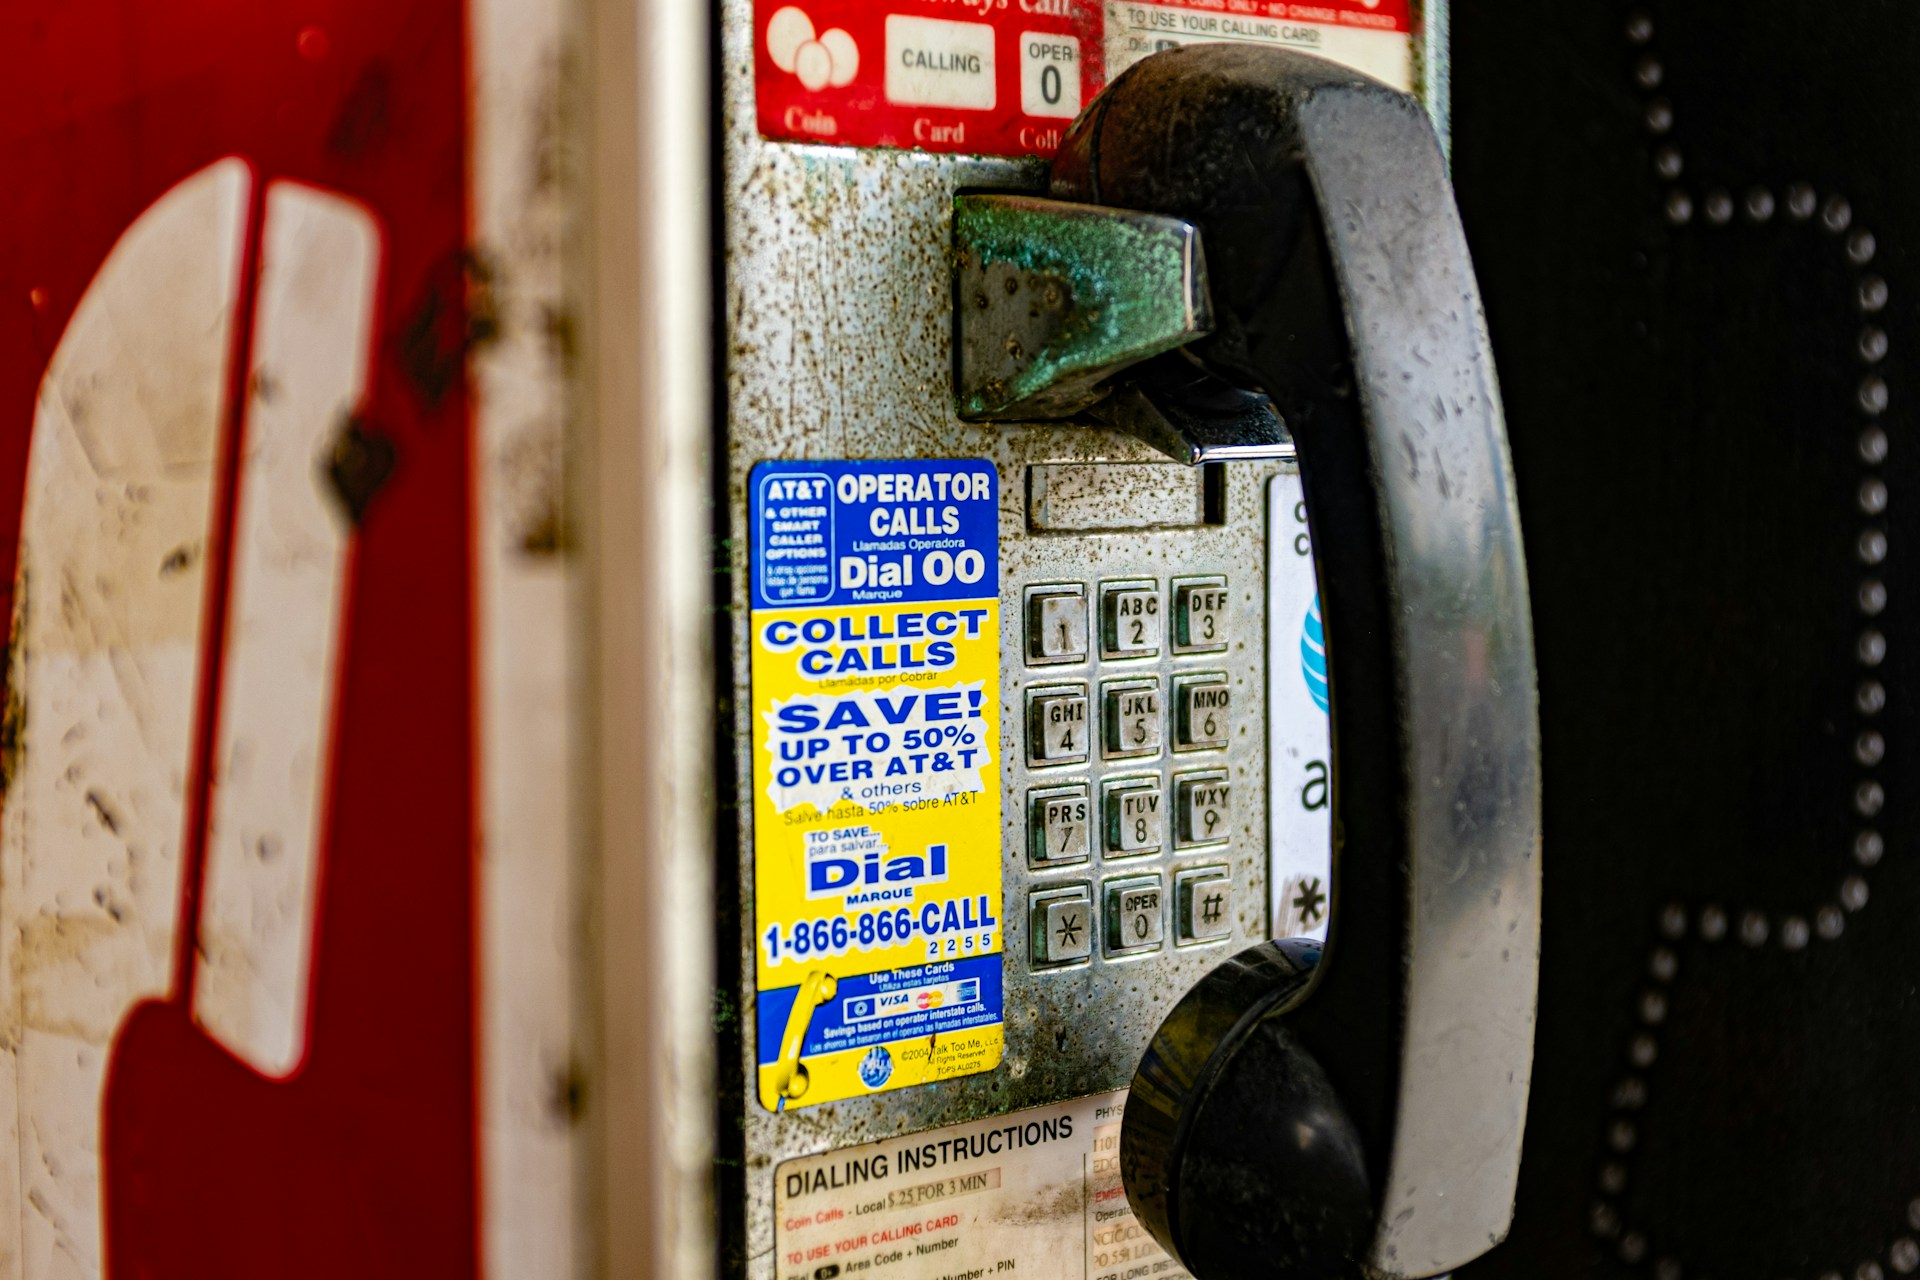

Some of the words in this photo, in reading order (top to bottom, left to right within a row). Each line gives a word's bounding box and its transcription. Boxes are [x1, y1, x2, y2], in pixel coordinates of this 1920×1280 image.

[1128, 8, 1146, 24] TO
[1151, 11, 1177, 27] USE
[1181, 15, 1217, 31] YOUR
[1222, 20, 1278, 38] CALLING
[902, 49, 981, 75] CALLING
[1029, 42, 1074, 62] OPER
[1041, 65, 1062, 105] 0
[784, 106, 838, 136] Coin
[913, 117, 965, 144] Card
[1020, 127, 1061, 150] Coll
[768, 480, 827, 500] AT&T
[837, 472, 990, 504] OPERATOR
[779, 506, 827, 519] OTHER
[869, 506, 960, 537] CALLS
[772, 520, 820, 533] SMART
[769, 533, 823, 546] CALLER
[852, 540, 906, 552] Llamadas
[908, 538, 965, 551] Operadora
[765, 547, 827, 560] OPTIONS
[840, 554, 913, 589] Dial
[852, 589, 903, 601] Marque
[1120, 597, 1158, 615] ABC
[1192, 592, 1228, 612] DEF
[765, 609, 987, 646] COLLECT
[1060, 623, 1068, 650] 1
[1131, 622, 1145, 645] 2
[1203, 614, 1215, 640] 3
[800, 641, 955, 675] CALLS
[818, 677, 874, 689] Llamadas
[878, 675, 896, 686] por
[899, 672, 938, 683] Cobrar
[1124, 695, 1156, 717] JKL
[1193, 689, 1229, 708] MNO
[777, 690, 982, 734] SAVE!
[1050, 703, 1083, 723] GHI
[1134, 718, 1146, 744] 5
[1204, 712, 1217, 737] 6
[780, 738, 830, 761] UP
[842, 732, 890, 755] TO
[903, 724, 976, 750] 50%
[1060, 725, 1074, 752] 4
[776, 760, 873, 788] OVER
[885, 749, 978, 776] AT&T
[841, 787, 854, 800] &
[861, 781, 922, 798] others
[1193, 786, 1230, 808] WXY
[783, 810, 822, 826] Salve
[826, 804, 864, 821] hasta
[869, 801, 899, 816] 50%
[903, 796, 939, 812] sobre
[943, 790, 979, 807] AT&T
[1048, 803, 1086, 824] PRS
[1125, 794, 1160, 816] TUV
[1135, 817, 1147, 843] 8
[1204, 809, 1218, 834] 9
[809, 831, 829, 843] TO
[1059, 826, 1073, 852] 7
[808, 843, 837, 858] para
[811, 845, 946, 892] Dial
[847, 887, 913, 905] MARQUE
[1126, 893, 1158, 913] OPER
[766, 896, 996, 959] 1-866-866-CALL
[1135, 914, 1148, 940] 0
[869, 973, 890, 985] Use
[892, 967, 923, 980] These
[925, 962, 955, 975] Cards
[923, 974, 950, 986] tarjetas
[880, 993, 909, 1007] VISA
[823, 1025, 856, 1039] Savings
[857, 1019, 882, 1033] based
[883, 1018, 894, 1029] on
[895, 1012, 928, 1028] operator
[930, 1006, 966, 1020] interstate
[967, 1001, 987, 1014] calls.
[901, 1049, 929, 1061] ©2004
[933, 1045, 948, 1056] Talk
[951, 1042, 966, 1052] Too
[968, 1038, 983, 1049] Me,
[937, 1055, 956, 1065] Rights
[957, 1049, 986, 1060] Reserved
[1095, 1104, 1124, 1120] PHYS
[786, 1155, 888, 1199] DIALING
[897, 1114, 1073, 1176] INSTRUCTIONS
[785, 1216, 812, 1232] Coin
[815, 1208, 844, 1224] Calls
[856, 1199, 886, 1216] Local
[917, 1183, 945, 1202] FOR
[949, 1180, 956, 1195] 3
[960, 1173, 988, 1193] MIN
[1095, 1186, 1124, 1203] EMER
[1095, 1206, 1132, 1223] Operato
[787, 1251, 803, 1265] TO
[806, 1244, 830, 1261] USE
[835, 1236, 868, 1254] YOUR
[871, 1223, 922, 1245] CALLING
[926, 1214, 958, 1232] CARD
[845, 1258, 871, 1274] Area
[874, 1250, 903, 1267] Code
[916, 1238, 959, 1257] Number
[997, 1258, 1015, 1273] PIN
[1121, 1266, 1149, 1280] LONG
